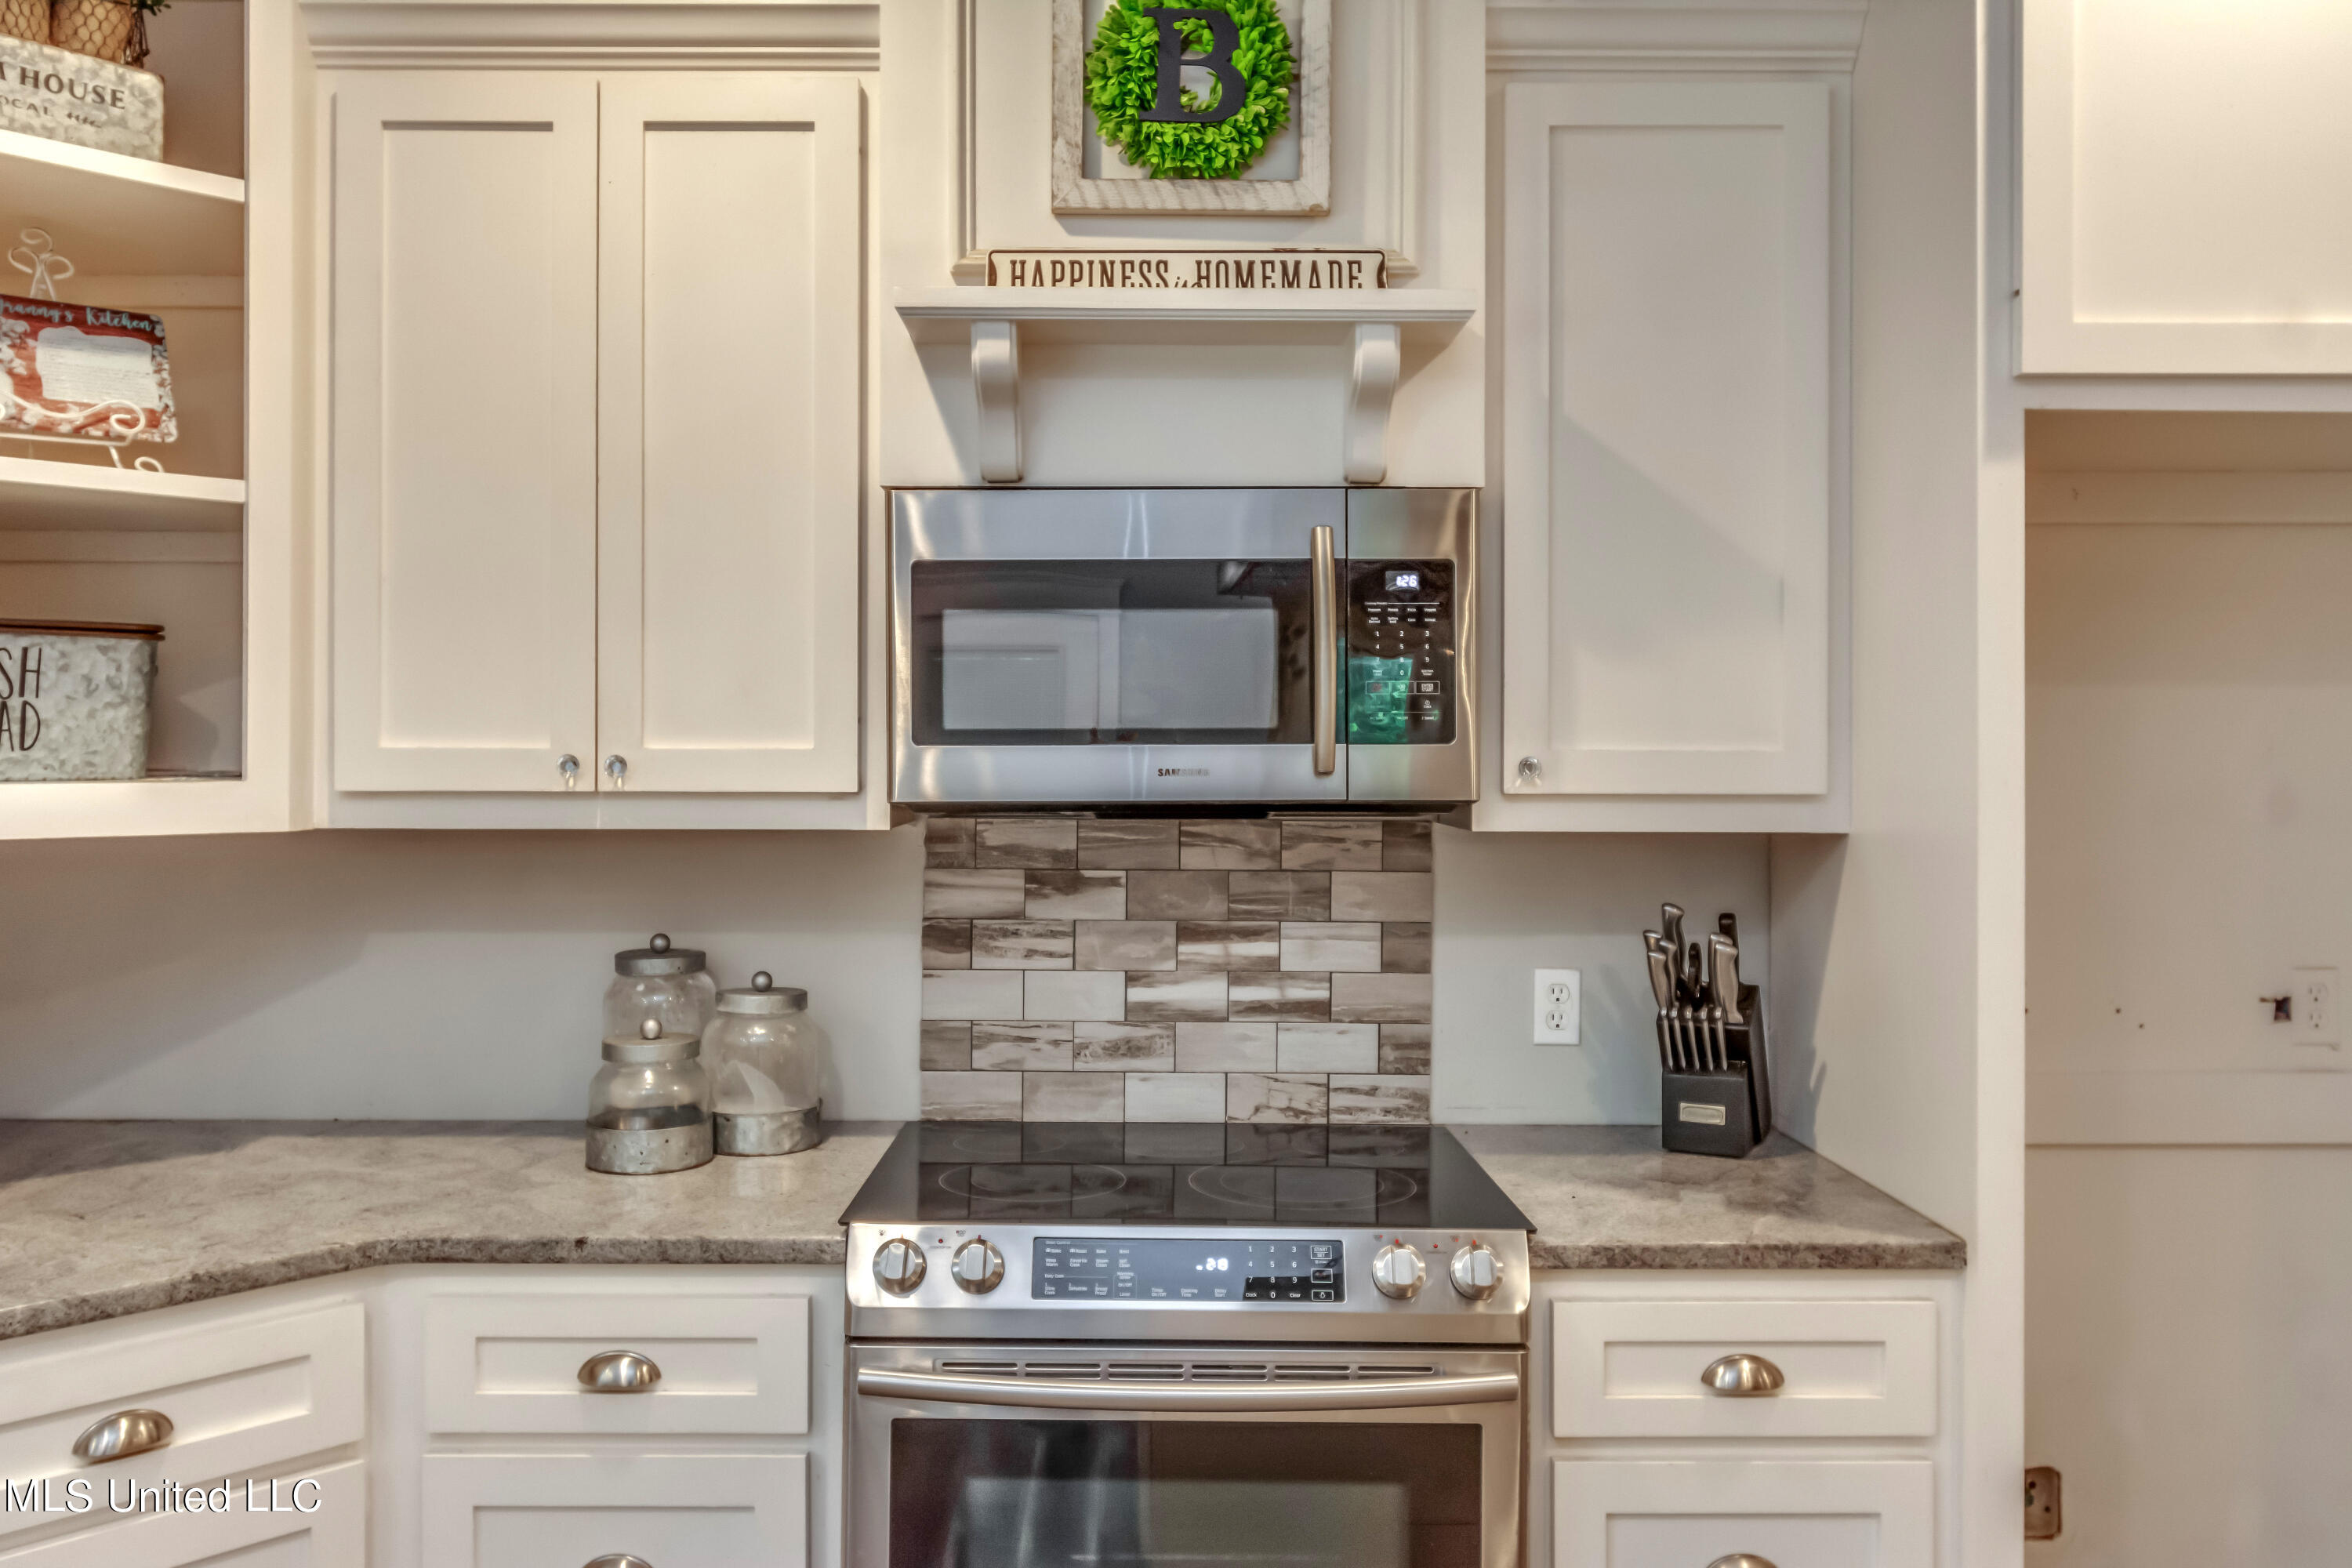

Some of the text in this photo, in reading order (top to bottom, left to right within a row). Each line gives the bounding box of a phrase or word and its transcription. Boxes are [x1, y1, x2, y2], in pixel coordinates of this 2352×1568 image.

[1139, 8, 1247, 122] B
[19, 66, 125, 110] HOUSE
[1010, 260, 1169, 288] HAPPINESS
[1195, 260, 1363, 289] HOMEMADE
[85, 307, 156, 332] Kitchen
